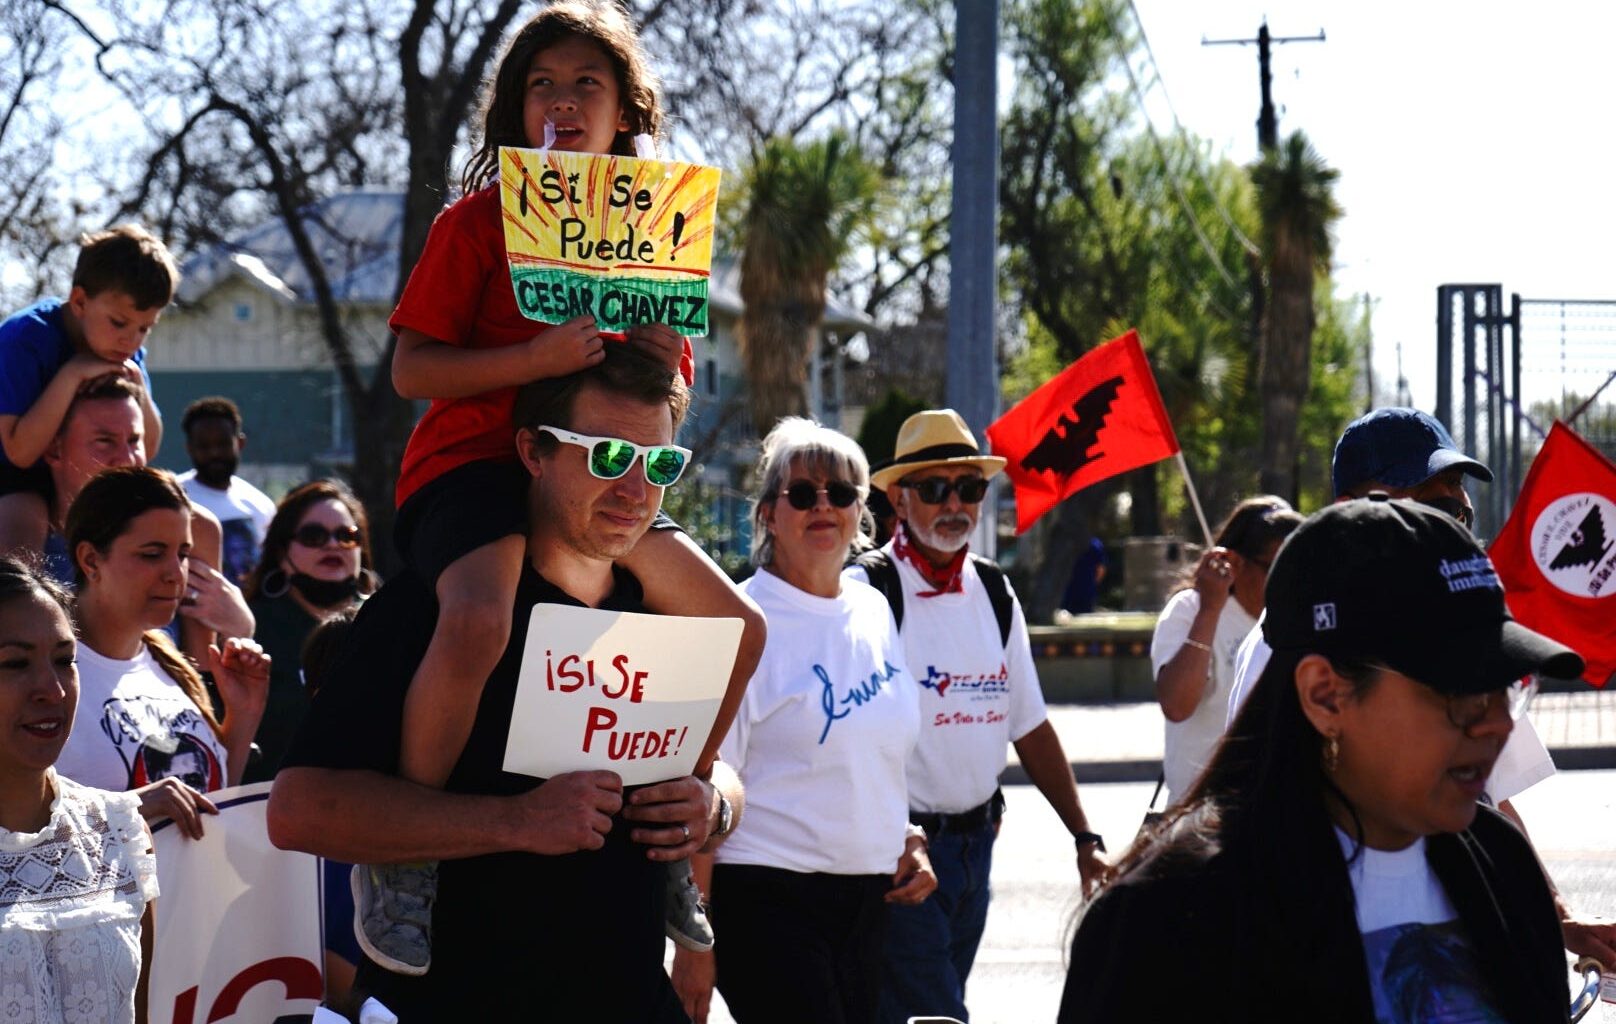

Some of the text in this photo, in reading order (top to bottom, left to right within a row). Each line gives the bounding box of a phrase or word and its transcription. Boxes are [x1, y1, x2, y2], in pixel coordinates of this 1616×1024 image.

[609, 174, 653, 211] Se
[517, 280, 706, 329] CESAR CHAVEZ
[602, 654, 649, 703] SE
